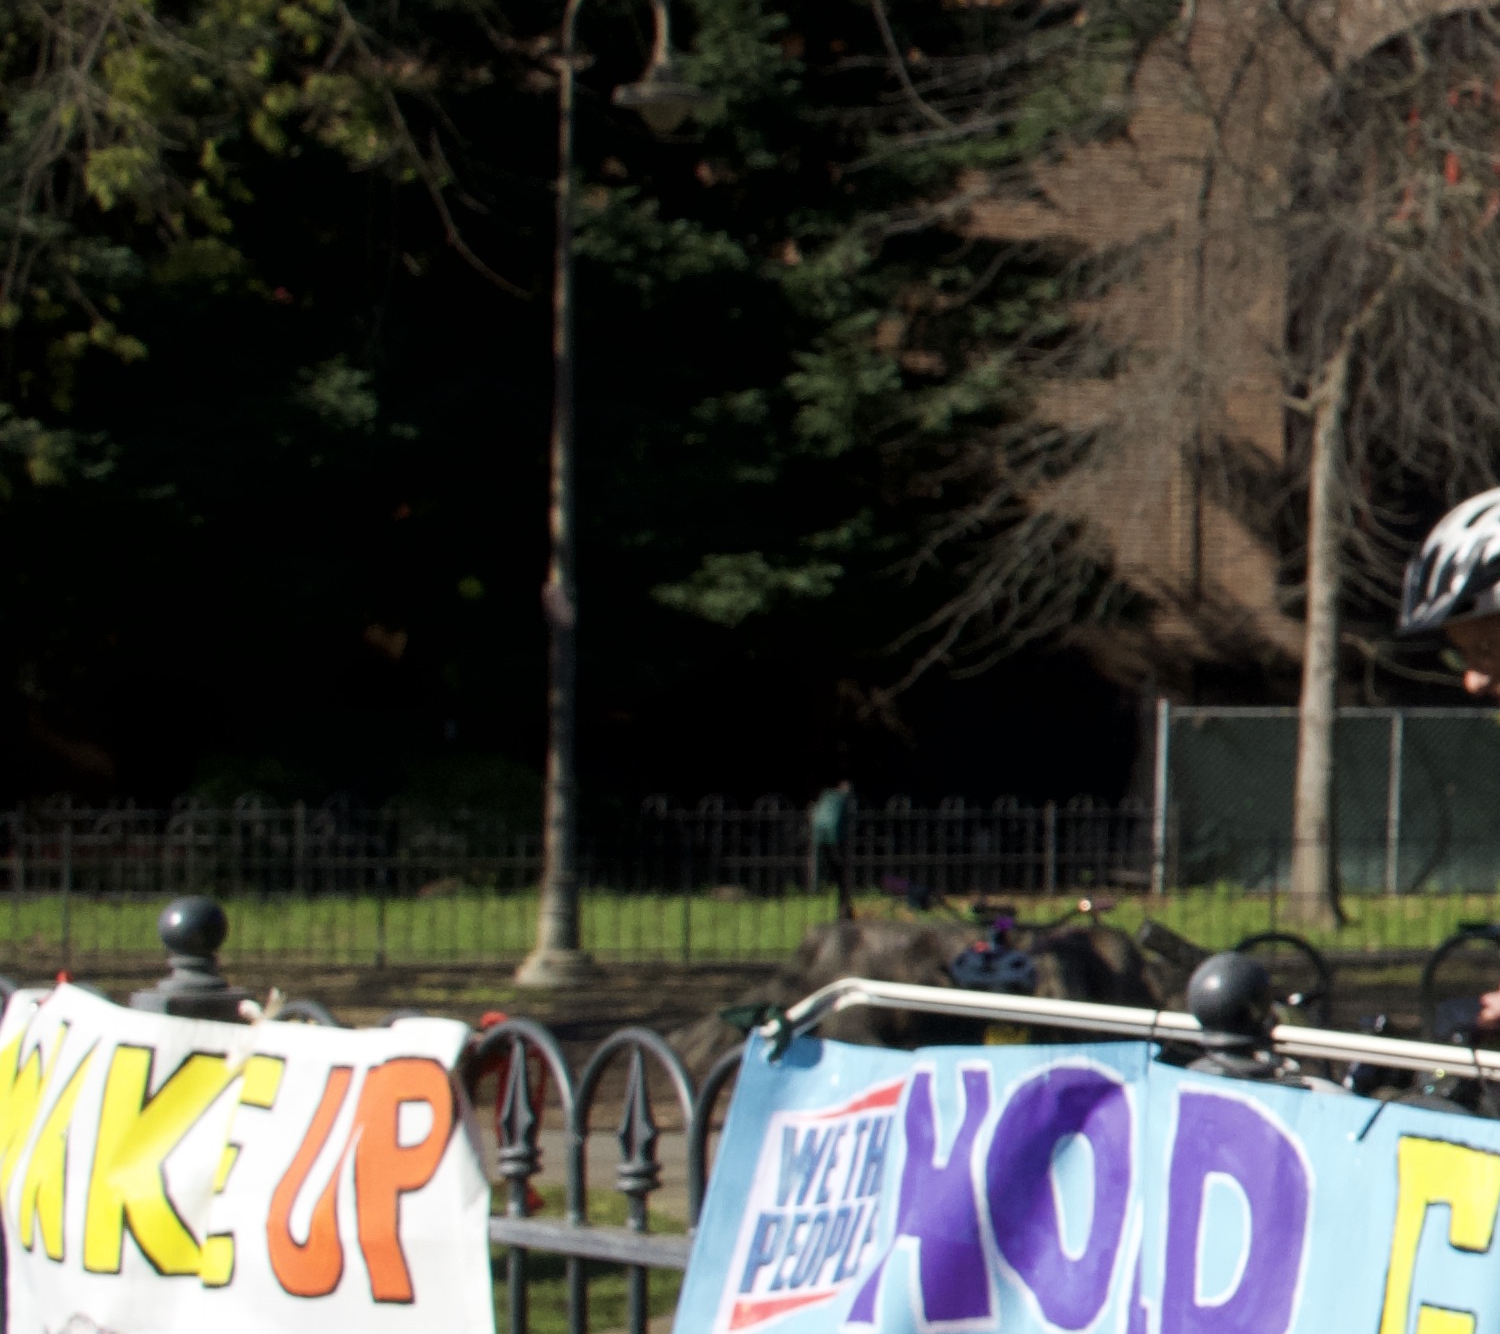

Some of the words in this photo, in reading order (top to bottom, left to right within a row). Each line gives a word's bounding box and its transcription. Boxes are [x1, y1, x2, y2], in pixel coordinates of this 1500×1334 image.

[266, 1055, 459, 1304] UP
[776, 1121, 849, 1208] WE
[838, 1115, 896, 1202] TH
